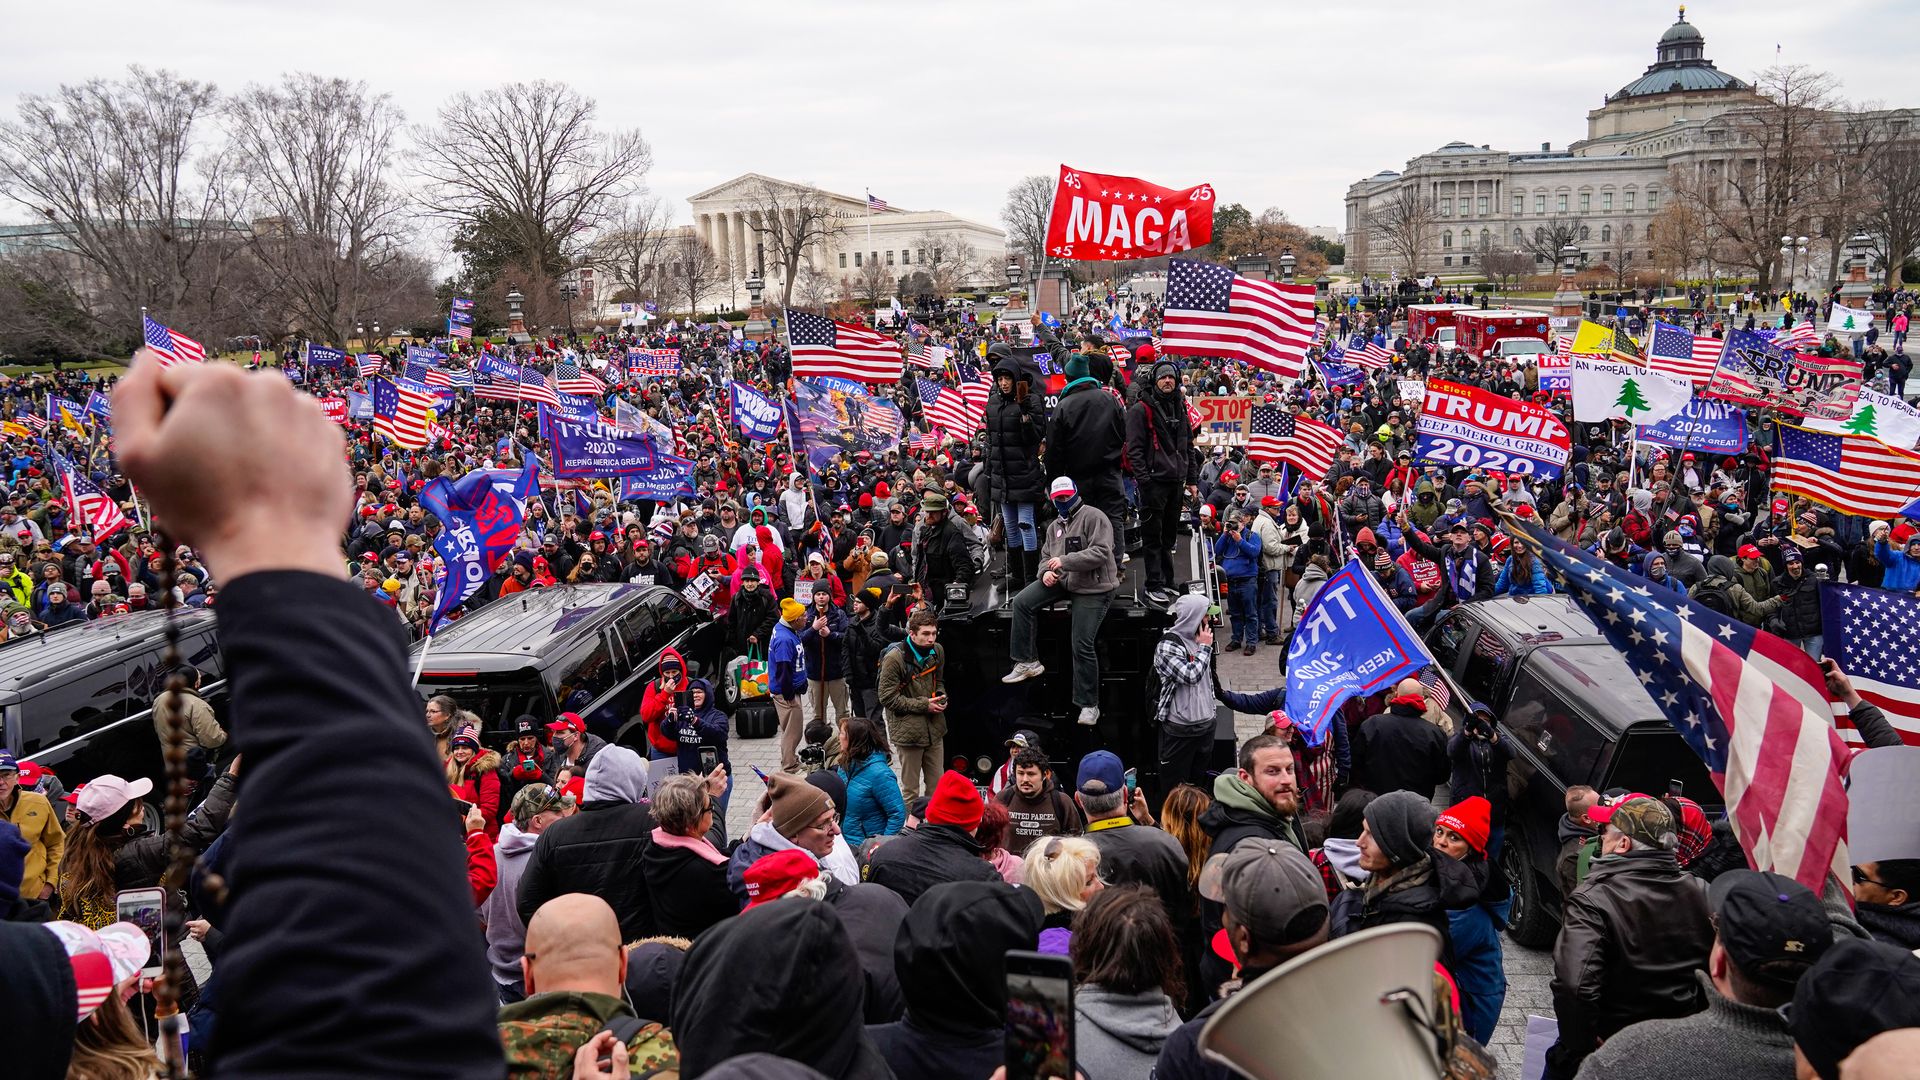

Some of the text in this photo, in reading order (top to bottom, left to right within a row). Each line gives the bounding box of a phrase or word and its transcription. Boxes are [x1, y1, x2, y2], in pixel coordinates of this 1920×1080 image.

[1063, 171, 1081, 190] 45
[1189, 186, 1212, 202] 45
[1065, 196, 1192, 254] MAGA
[1052, 244, 1074, 257] 45
[1121, 329, 1148, 338] TRUMP
[312, 349, 341, 358] TRUMP
[410, 348, 437, 359] TRUMP
[629, 353, 680, 369] TRUMP
[1541, 355, 1570, 367] TRU
[485, 356, 519, 377] TRUMP
[1575, 360, 1589, 371] AN
[1633, 366, 1647, 376] TO
[826, 378, 863, 396] TRUMP
[1397, 381, 1424, 390] TRUMP
[1550, 377, 1570, 389] 20
[95, 394, 112, 409] TRU
[558, 394, 590, 406] UMP
[732, 382, 781, 422] TRUMP
[1043, 395, 1058, 408] 20
[1858, 390, 1874, 402] EAL
[1877, 395, 1890, 406] TO
[563, 405, 581, 414] 020-
[1199, 398, 1253, 422] STOP
[1425, 390, 1567, 440] TRUMP
[1520, 405, 1551, 417] Dona
[1679, 400, 1737, 420] UMP
[430, 422, 456, 440] TRU
[1210, 421, 1243, 433] THE
[1670, 420, 1718, 435] -2020-
[1196, 427, 1249, 446] STEAL
[1416, 418, 1564, 461] KEEP AMERICA GREAT!
[1645, 428, 1668, 439] KEEP
[1708, 438, 1738, 447] GREAT!
[583, 441, 623, 455] -2020-
[565, 458, 591, 467] KEEPING
[593, 458, 620, 467] AMERICA
[621, 457, 648, 467] GREAT!
[1425, 438, 1534, 474] 2020
[679, 735, 703, 744] GREAT
[1030, 813, 1056, 821] PARCEL
[1015, 827, 1043, 836] SERVICE
